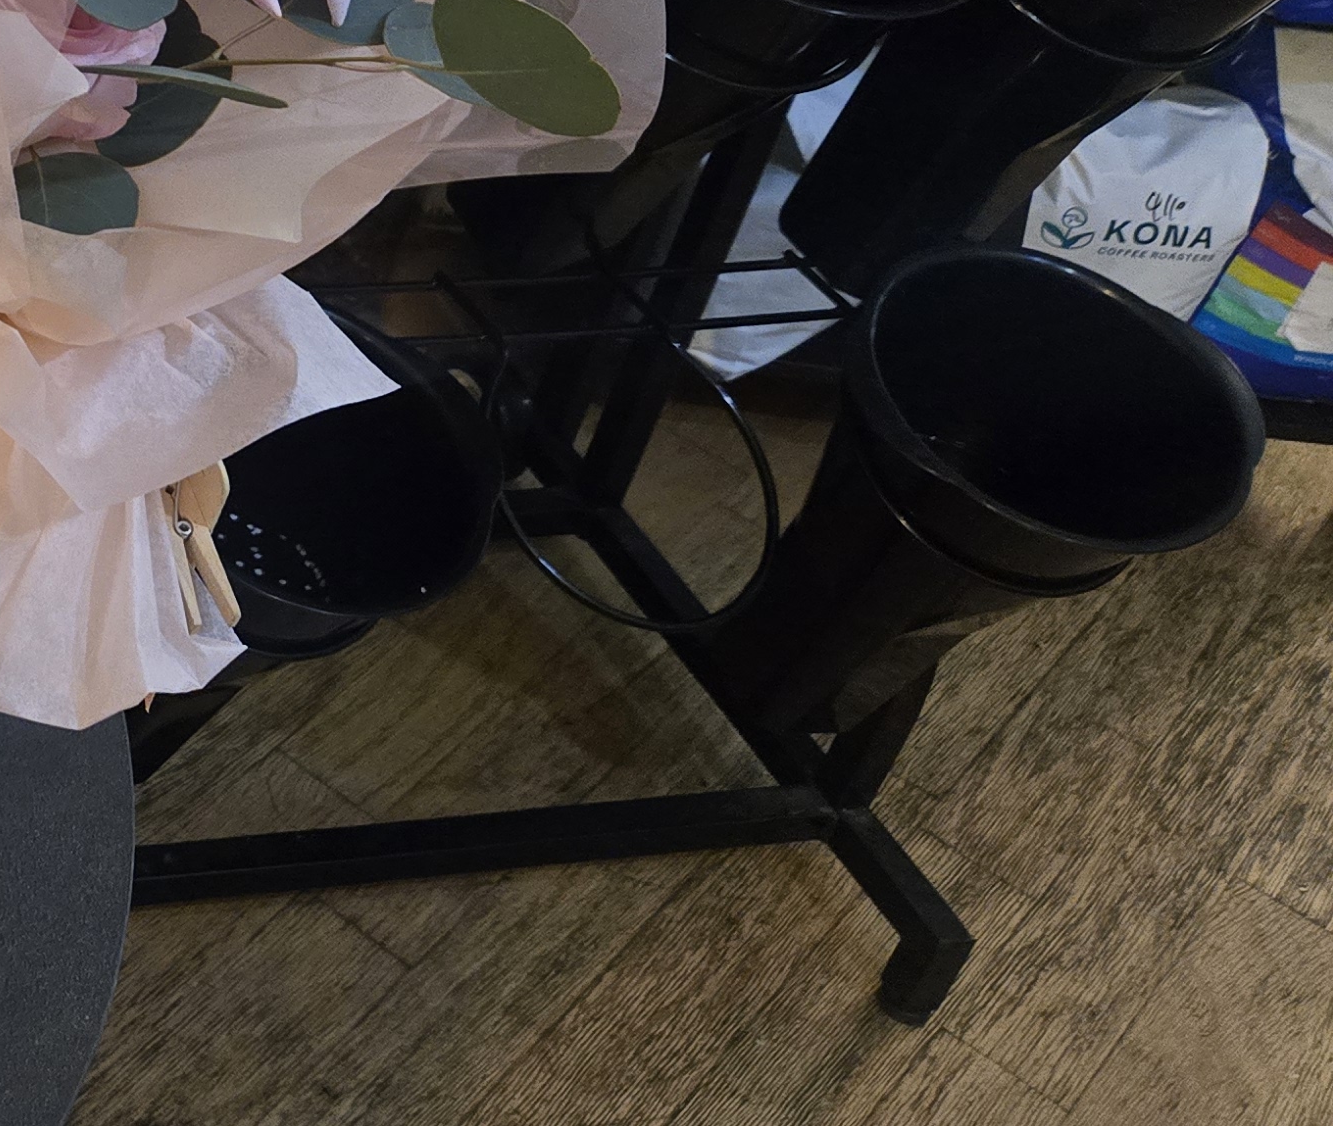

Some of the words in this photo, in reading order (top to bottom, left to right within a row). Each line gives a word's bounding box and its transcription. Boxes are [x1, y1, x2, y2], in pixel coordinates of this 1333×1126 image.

[1102, 219, 1213, 249] KONA
[1097, 246, 1149, 259] COFFEE
[1150, 251, 1216, 263] ROASTERS
